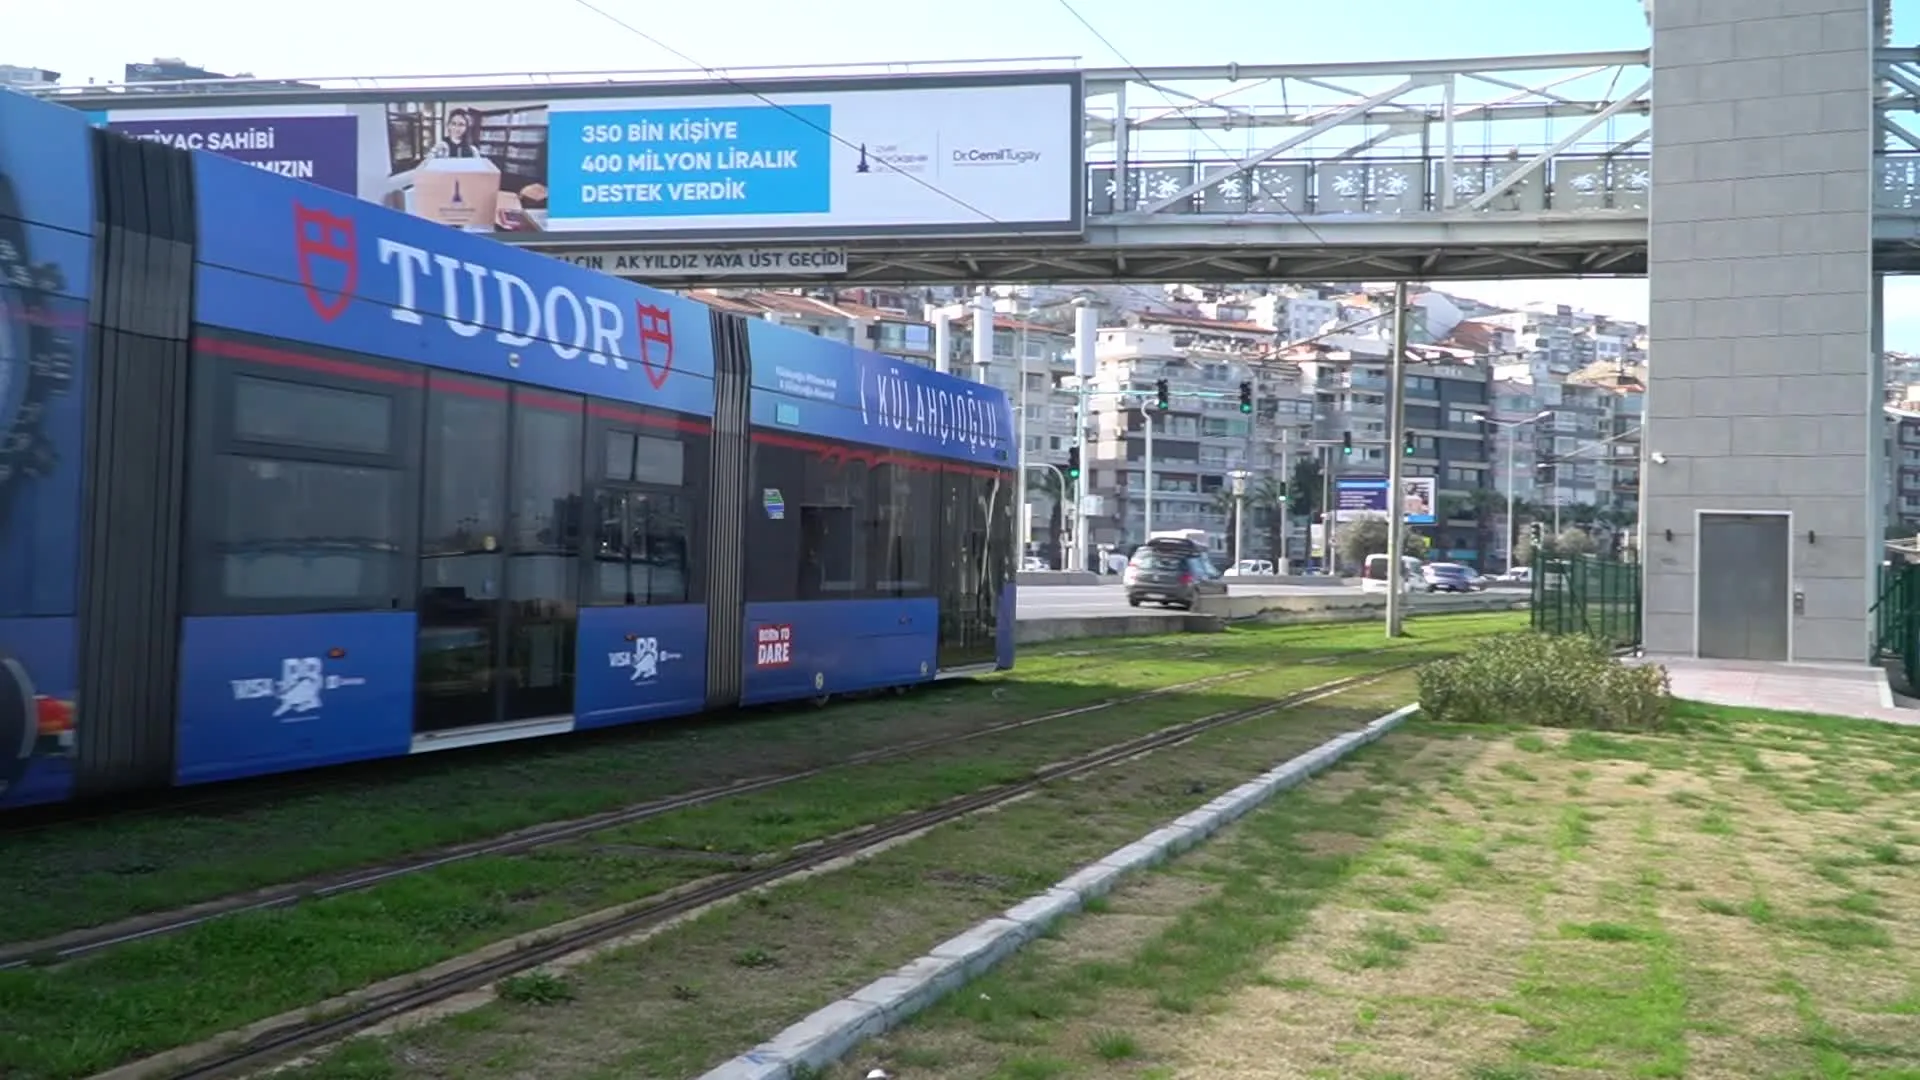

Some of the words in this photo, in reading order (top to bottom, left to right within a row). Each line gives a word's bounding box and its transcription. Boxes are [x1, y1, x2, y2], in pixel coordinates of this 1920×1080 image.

[207, 127, 274, 149] SAHİBİ
[581, 125, 622, 143] 350
[628, 119, 663, 141] BİN
[670, 118, 737, 144] KİŞİYE
[581, 155, 622, 172] 400
[628, 149, 711, 171] MİLYON
[717, 147, 798, 169] LİRALIK
[581, 183, 662, 203] DESTEK
[668, 177, 746, 200] VERDİK
[704, 252, 744, 268] YAYA
[750, 249, 782, 267] ÜST
[788, 247, 845, 268] GEÇİDİ
[377, 237, 628, 371] TUDOR
[758, 642, 790, 665] DARE
